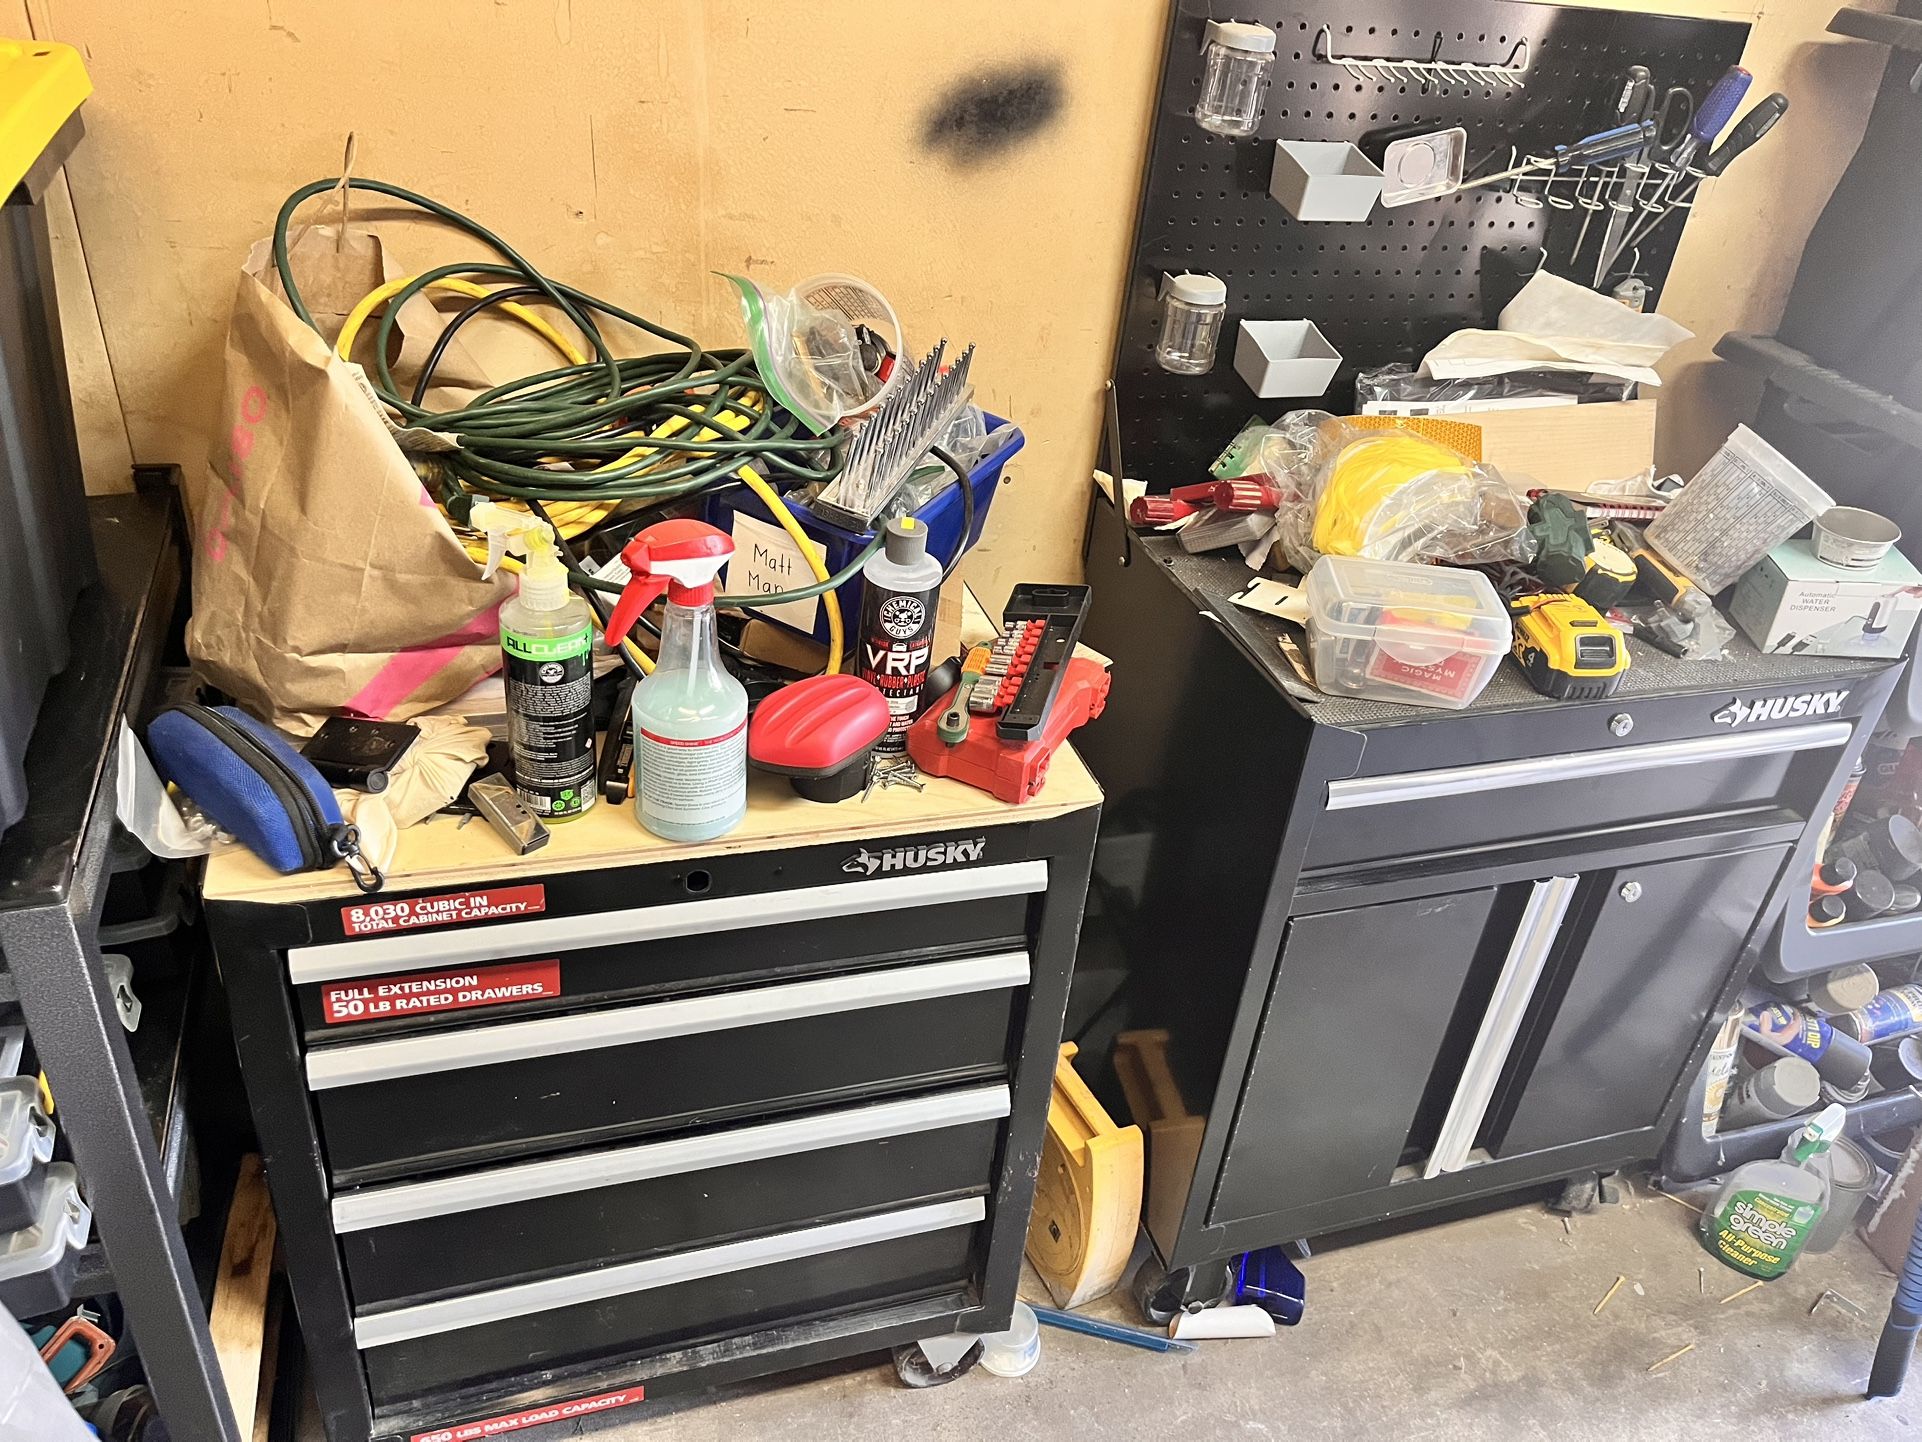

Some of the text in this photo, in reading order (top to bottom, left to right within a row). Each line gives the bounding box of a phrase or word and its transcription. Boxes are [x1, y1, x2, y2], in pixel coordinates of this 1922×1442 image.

[753, 543, 792, 576] Matt
[884, 599, 922, 619] CHEMICAL
[1790, 604, 1837, 612] DISPENSER
[1799, 591, 1837, 599] Automatic
[889, 625, 914, 636] GUYS
[866, 643, 930, 676] VRP
[1401, 665, 1441, 681] MAGIC
[880, 674, 904, 689] RUBBER
[1747, 690, 1850, 723] HUSKY
[881, 838, 986, 872] HUSKY
[350, 895, 488, 923] 8,030 CUBIC IN
[352, 902, 528, 931] TOTAL CABINET CAPACITY
[330, 975, 478, 1002] FULL EXTENSION
[332, 982, 543, 1018] 50 LB RATED DRAWERS
[1806, 1032, 1821, 1049] DIP
[1729, 1214, 1788, 1250] green
[1734, 1201, 1797, 1239] simple
[1718, 1240, 1758, 1267] Cleaner
[1719, 1229, 1781, 1264] All-Purpose
[456, 1426, 482, 1438] LBS
[484, 1418, 518, 1432] MAX
[521, 1409, 559, 1424] LOAD
[562, 1394, 627, 1415] CAPACITY
